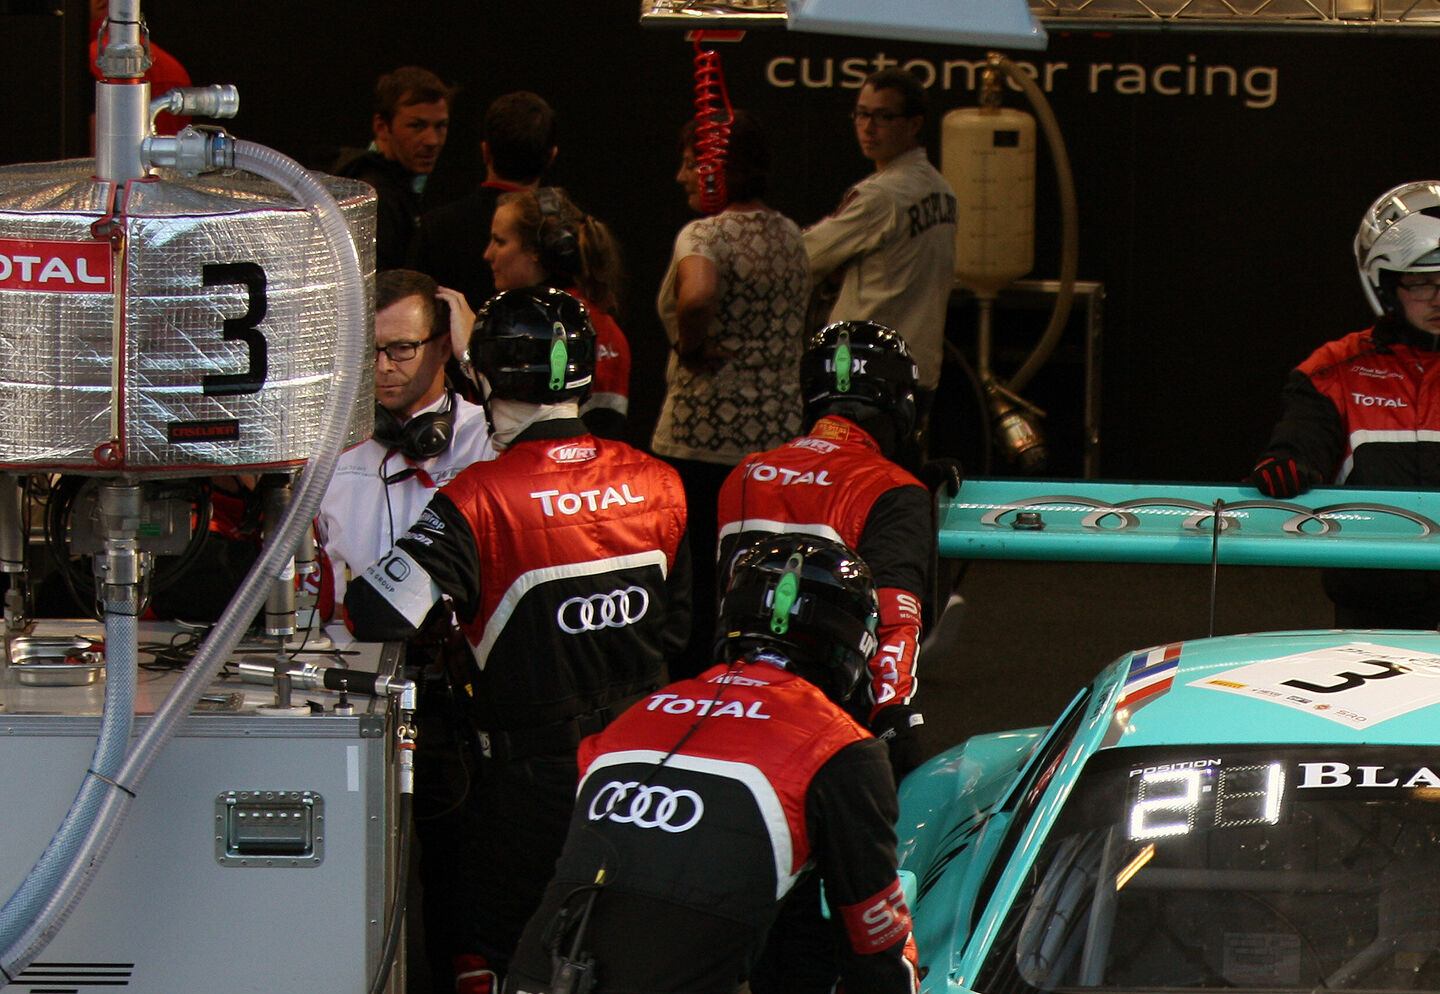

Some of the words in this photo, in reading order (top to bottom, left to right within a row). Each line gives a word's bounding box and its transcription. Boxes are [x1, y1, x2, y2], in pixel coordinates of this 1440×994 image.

[766, 52, 1067, 92] customer
[1089, 55, 1278, 109] racing
[0, 255, 106, 285] TAL
[202, 262, 268, 397] 3
[1351, 392, 1408, 408] TOTAL
[560, 447, 597, 460] WRT
[745, 461, 833, 486] TOTAL
[530, 483, 645, 516] TOTAL
[1279, 659, 1413, 694] 3
[646, 693, 771, 720] TOTAL
[1129, 759, 1222, 778] POSITION
